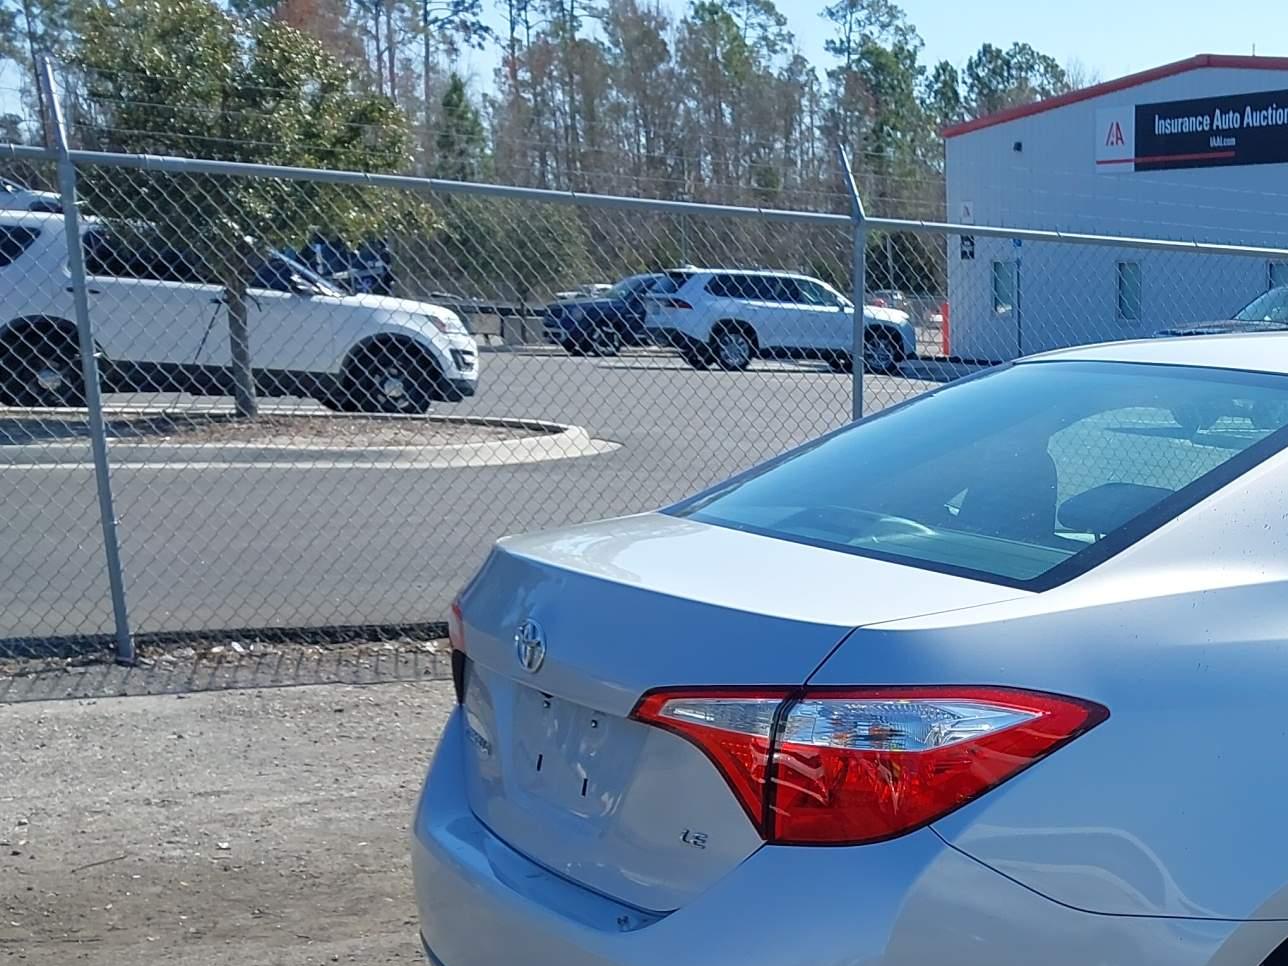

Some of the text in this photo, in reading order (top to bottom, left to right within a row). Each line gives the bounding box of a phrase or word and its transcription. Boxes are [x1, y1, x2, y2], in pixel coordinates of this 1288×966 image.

[1154, 114, 1210, 135] Insurance
[1213, 108, 1241, 130] Auto
[680, 829, 708, 849] LE
